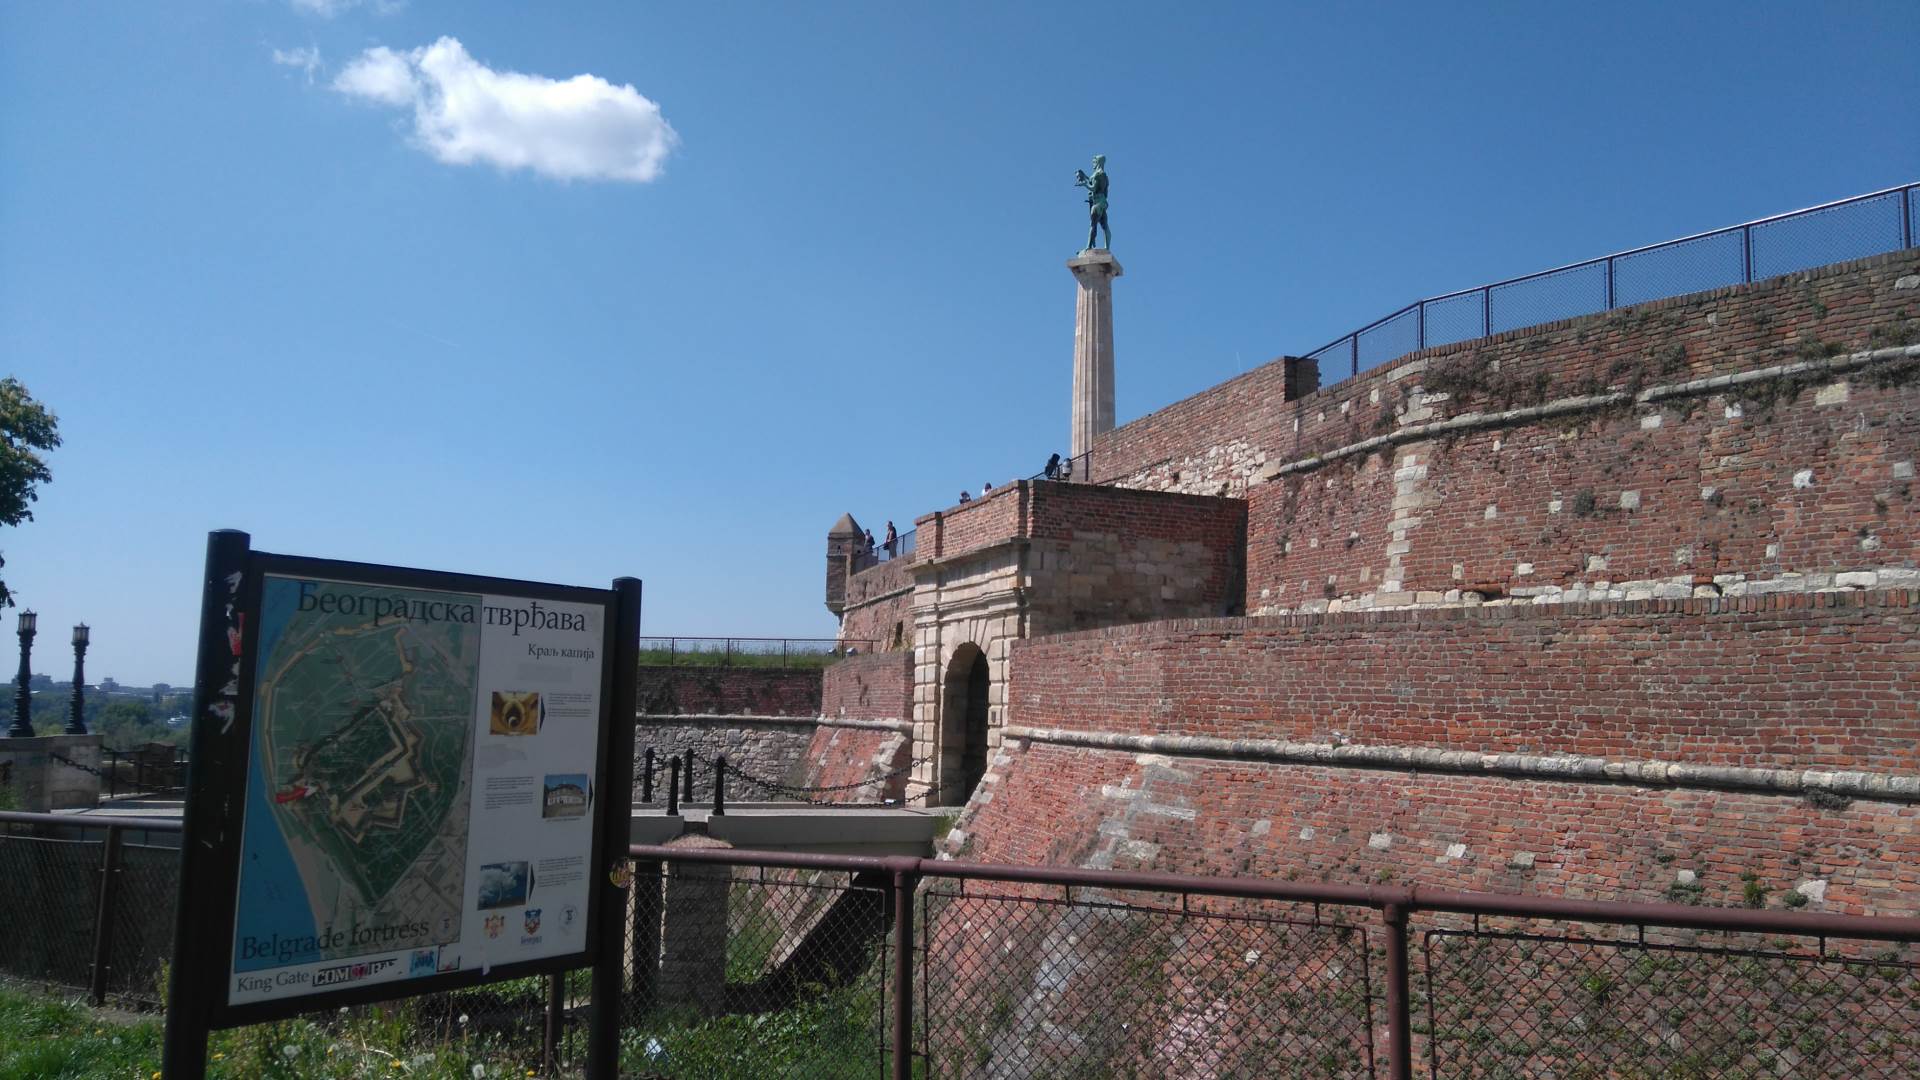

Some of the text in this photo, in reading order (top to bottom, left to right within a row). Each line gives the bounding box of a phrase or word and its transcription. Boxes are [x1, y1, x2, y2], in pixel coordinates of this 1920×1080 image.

[297, 582, 586, 635] Београдска тврђава
[528, 643, 595, 662] Краљ капија
[241, 927, 344, 963] Belgrade
[349, 919, 430, 946] fortress
[237, 970, 310, 993] King Gate
